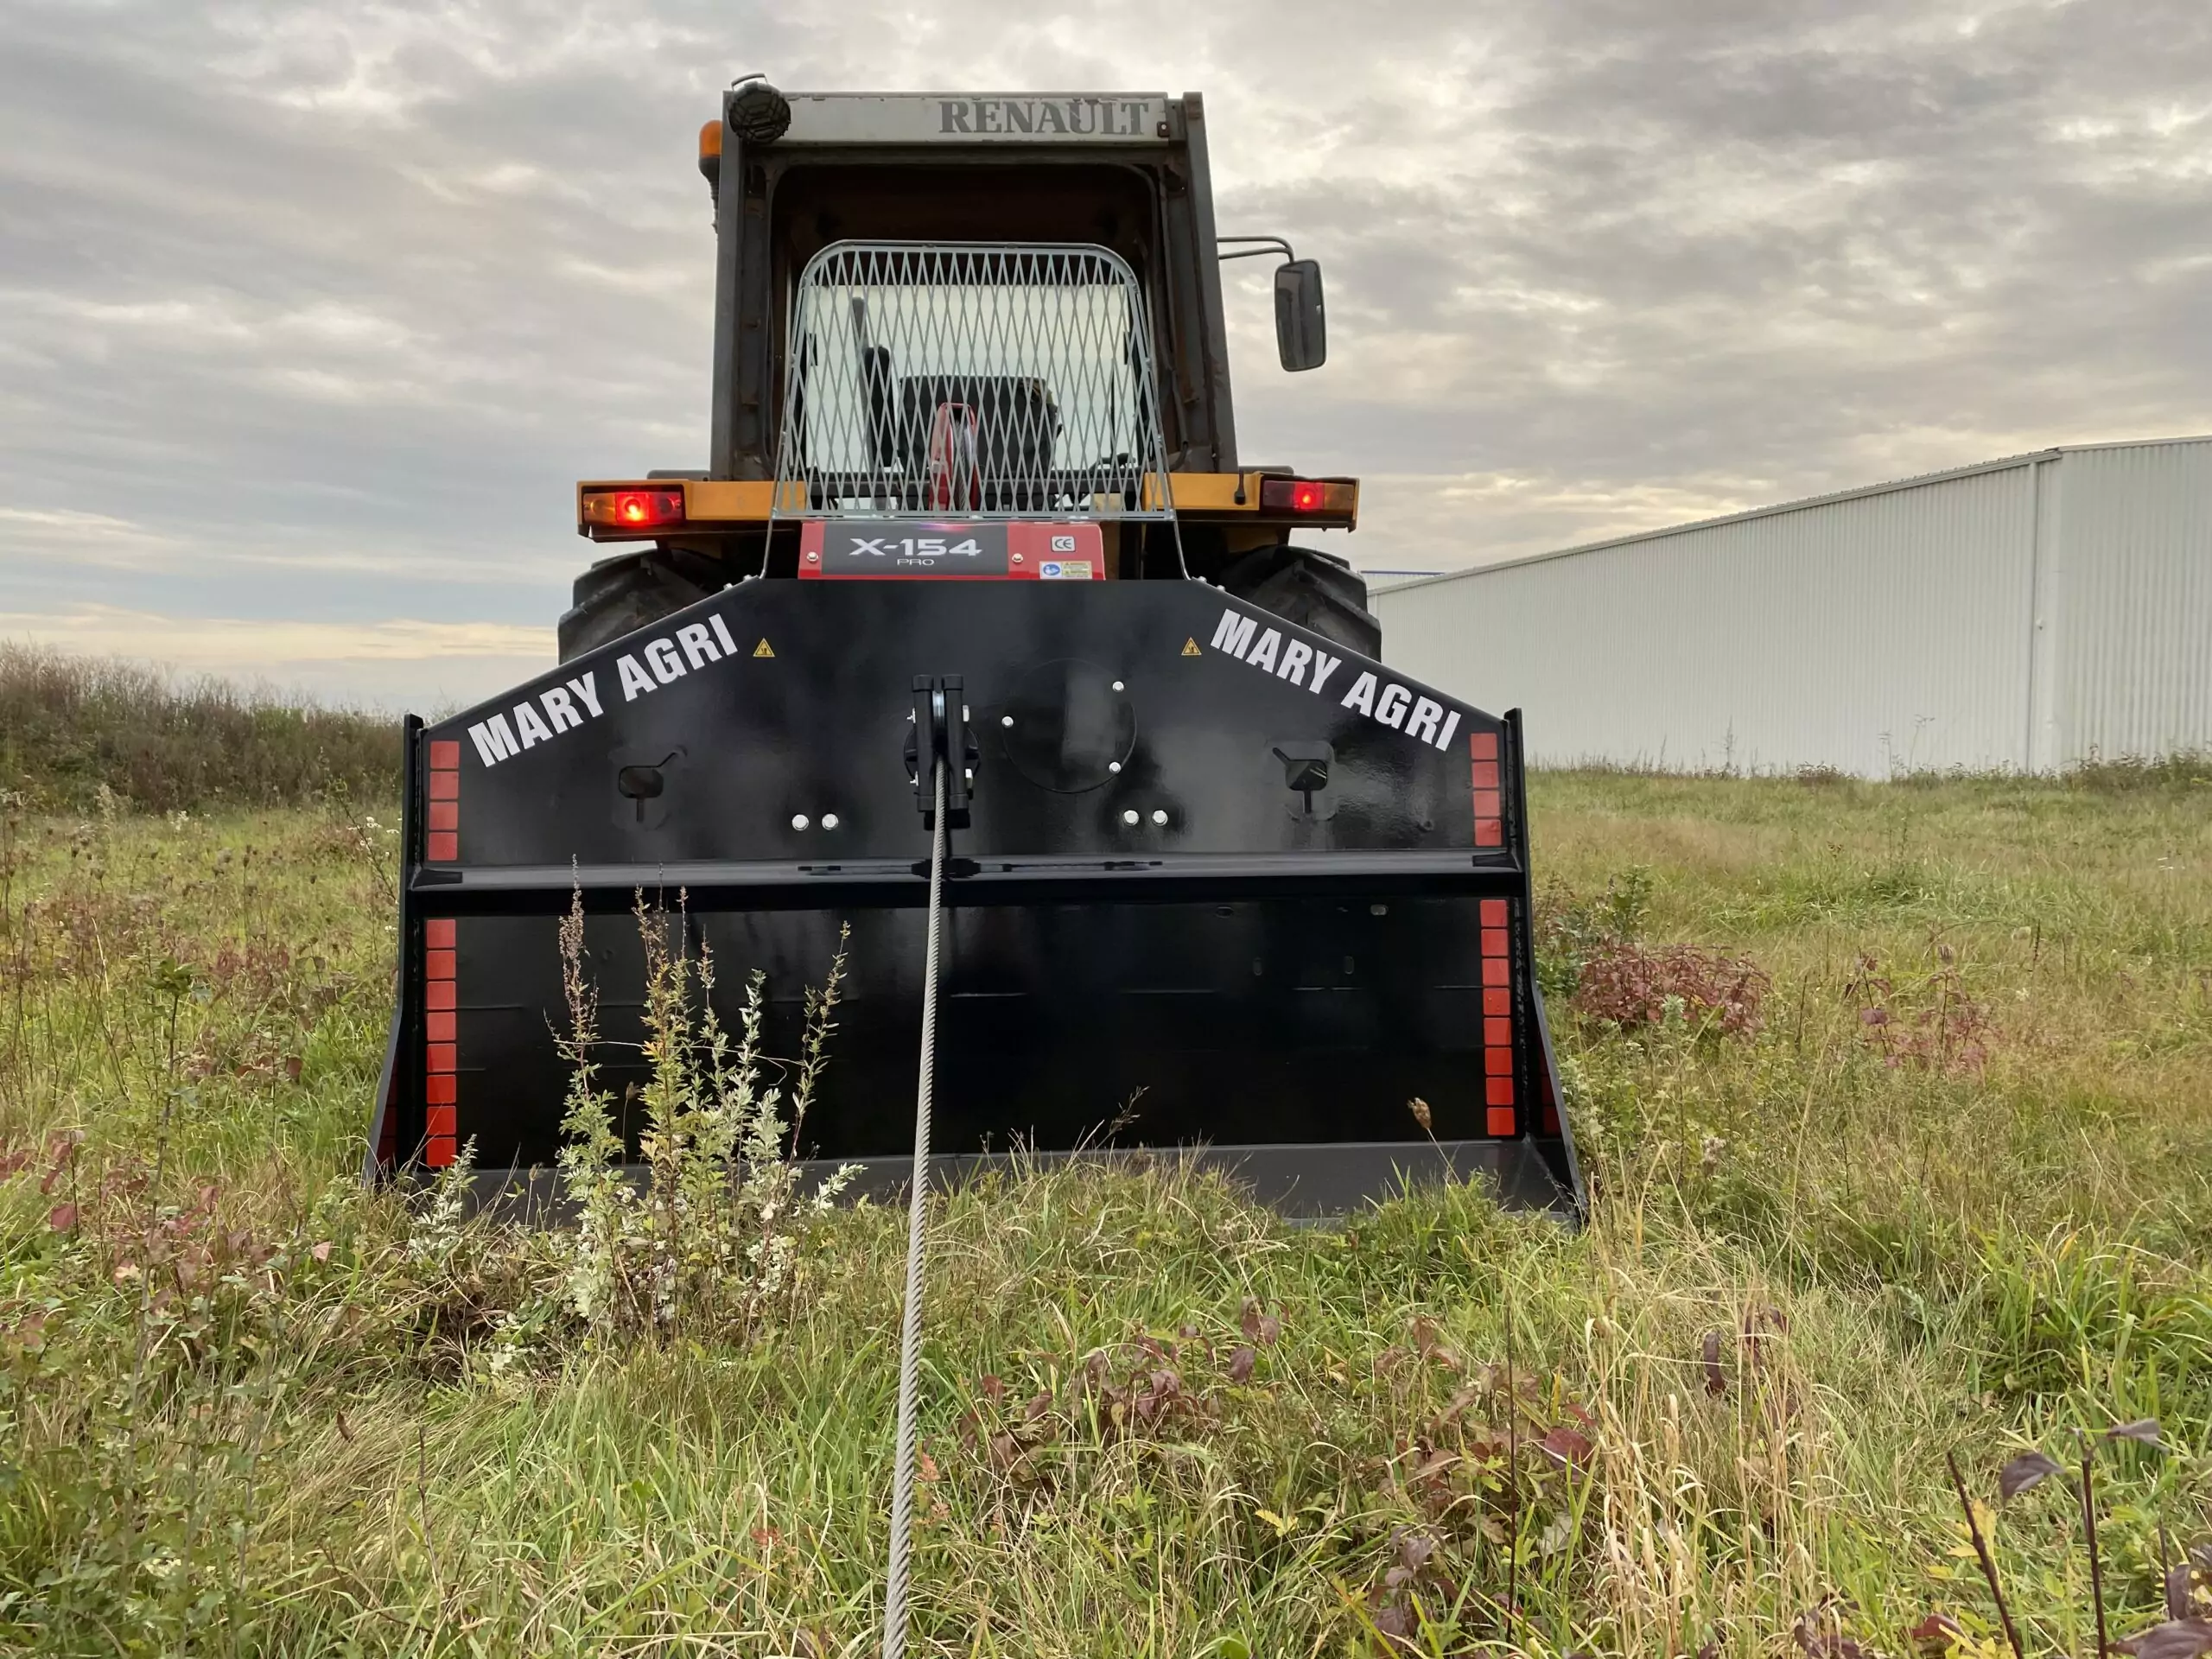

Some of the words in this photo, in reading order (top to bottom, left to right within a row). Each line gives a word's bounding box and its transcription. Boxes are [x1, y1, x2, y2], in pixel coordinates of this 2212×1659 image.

[939, 100, 1149, 135] RENAULT
[849, 537, 982, 556] X-154
[1054, 538, 1072, 550] CE
[467, 671, 604, 768] MARY
[615, 613, 738, 702] AGRI
[1211, 608, 1342, 695] MARY
[1341, 671, 1462, 751] AGRI
